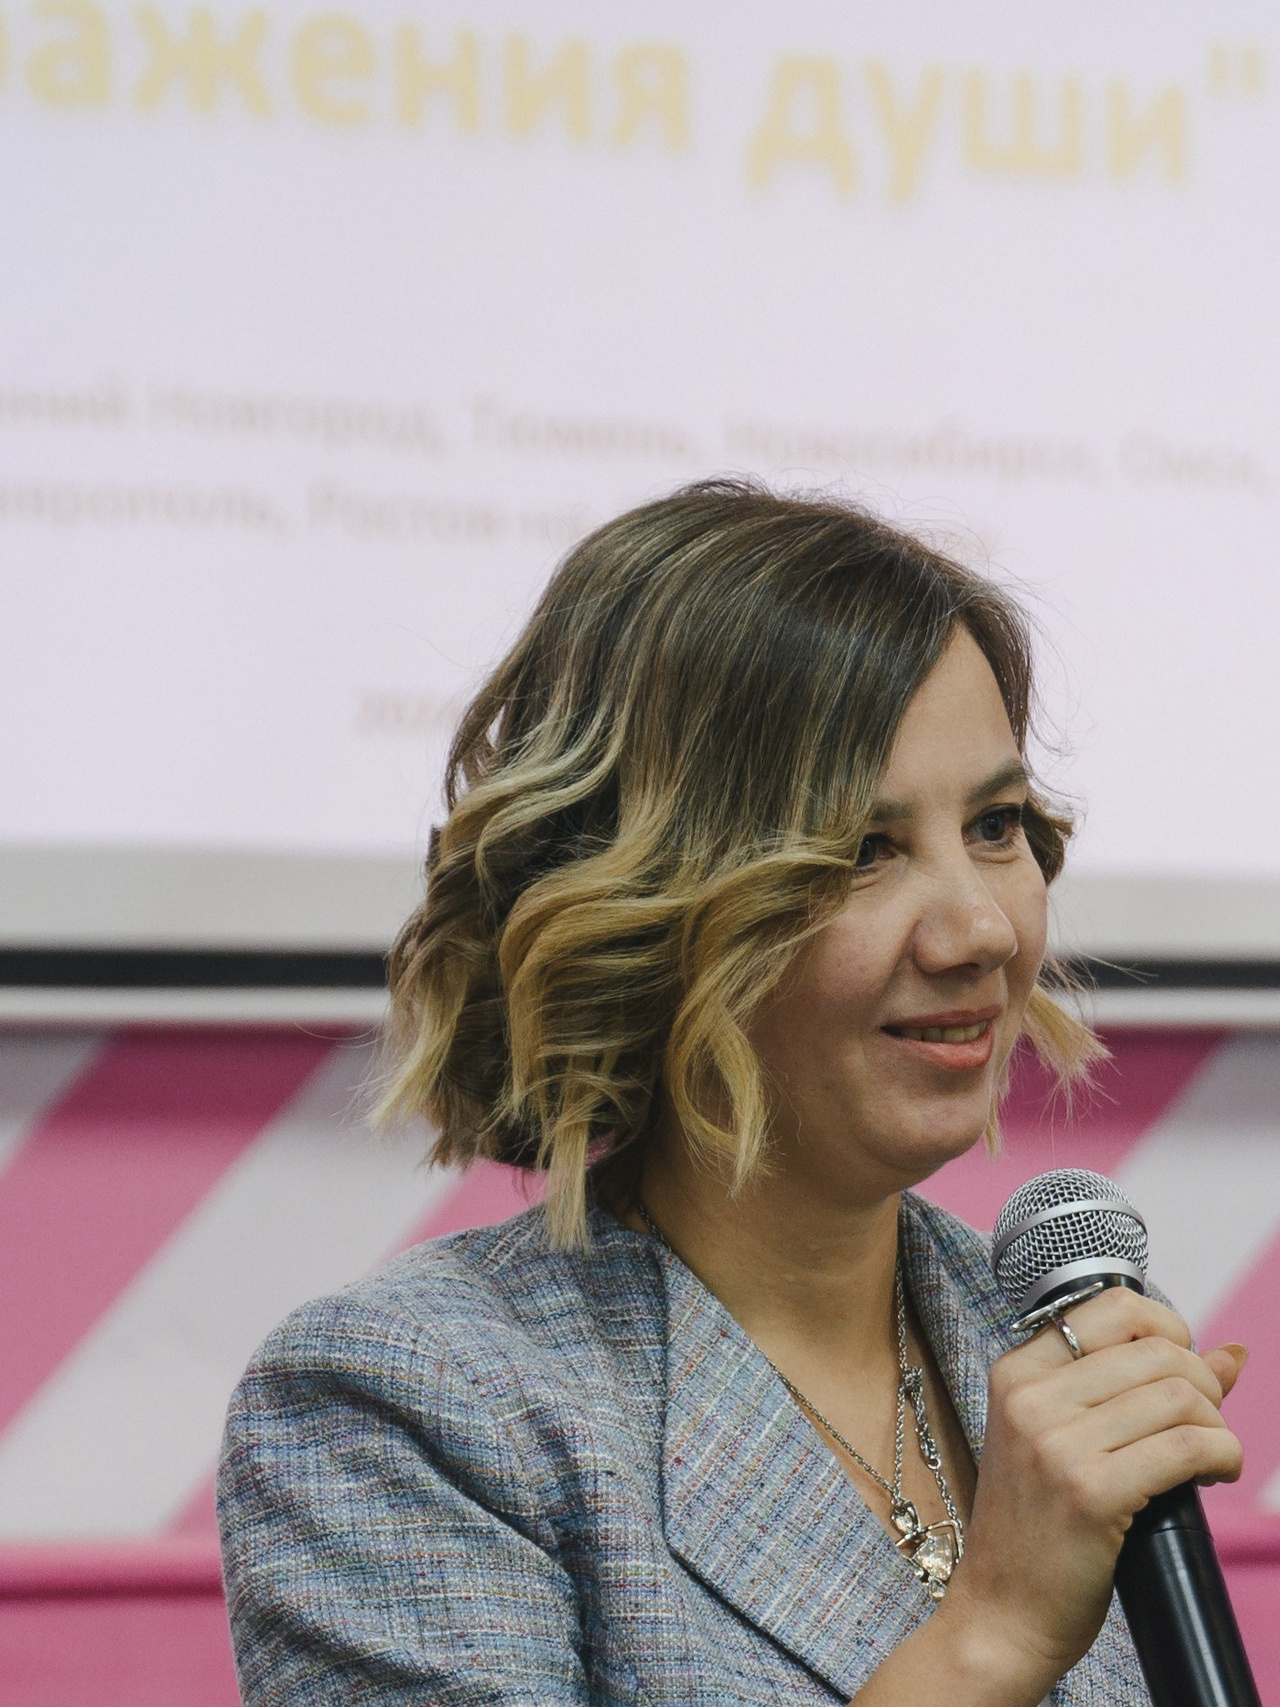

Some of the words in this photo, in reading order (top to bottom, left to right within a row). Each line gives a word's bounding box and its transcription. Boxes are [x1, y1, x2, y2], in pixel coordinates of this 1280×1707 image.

[0, 0, 690, 153] ажения
[746, 38, 1266, 207] души"
[0, 370, 130, 432] ний
[0, 478, 287, 538] врополь,
